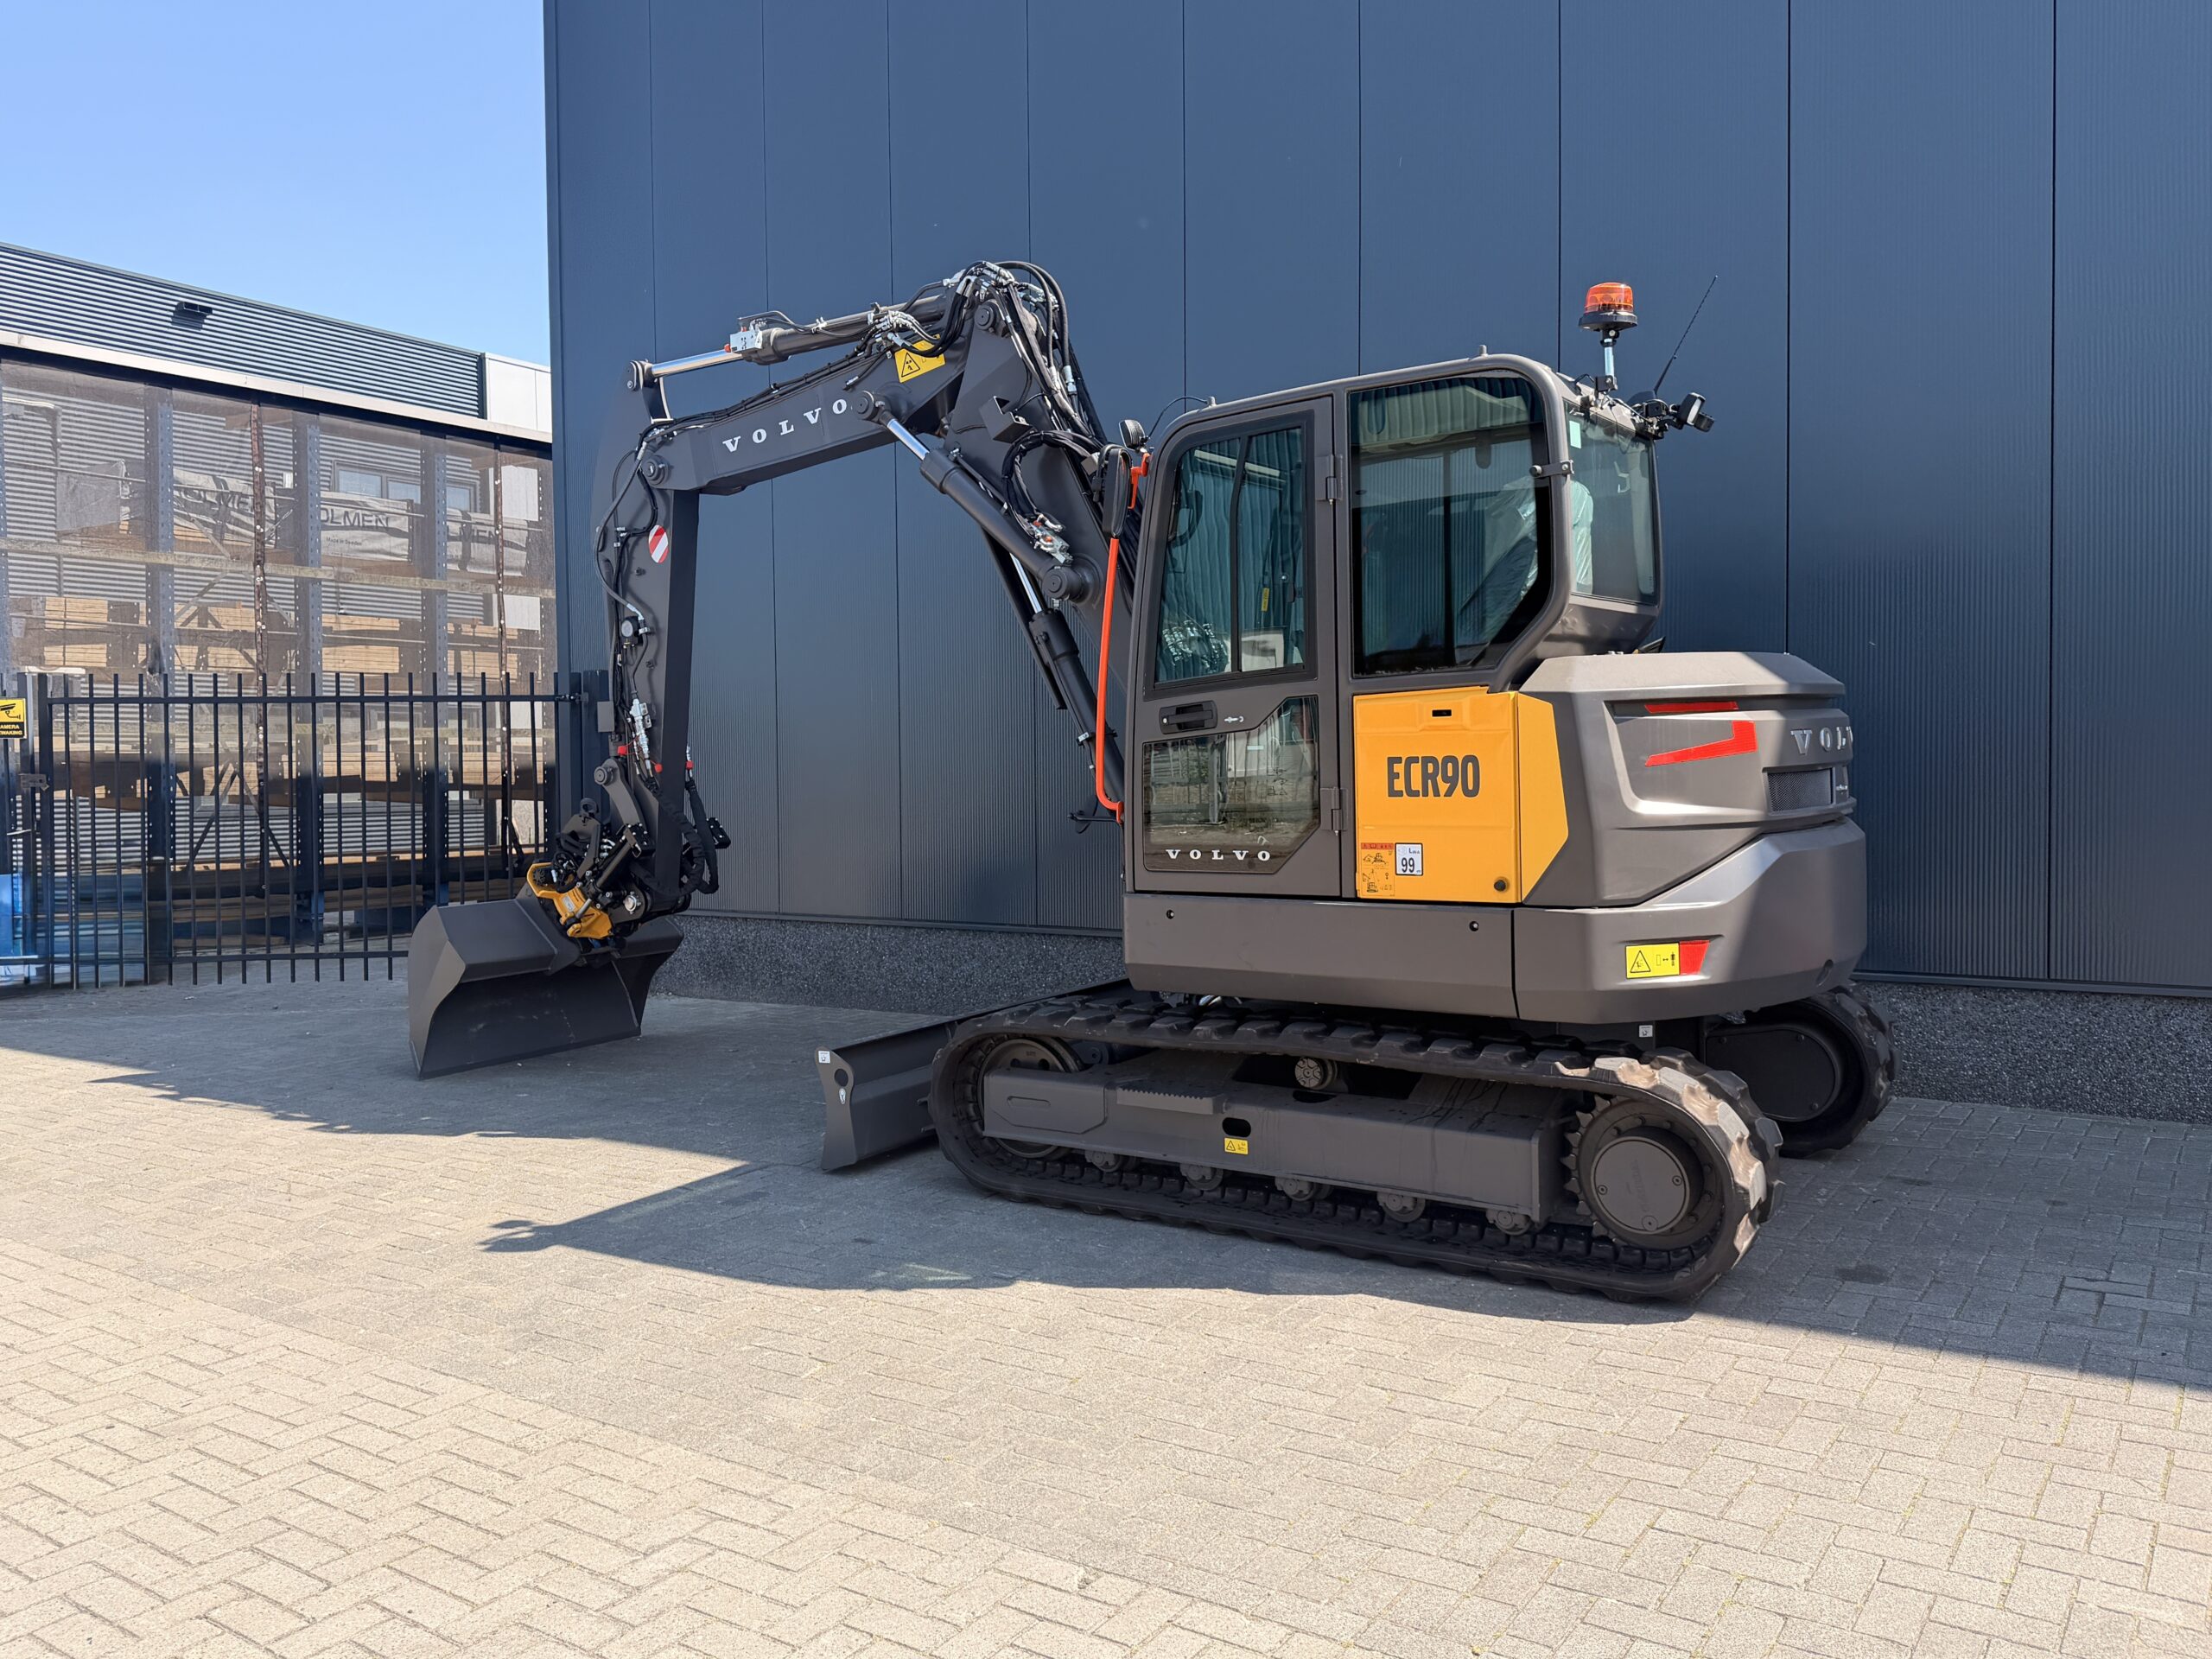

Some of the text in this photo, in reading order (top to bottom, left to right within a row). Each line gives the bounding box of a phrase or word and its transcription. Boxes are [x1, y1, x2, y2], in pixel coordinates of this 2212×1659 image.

[721, 398, 848, 453] VOLVO
[320, 507, 389, 529] OLMEN
[1386, 754, 1481, 798] ECR90
[1165, 849, 1271, 861] VOLVO
[1401, 856, 1415, 874] 99
